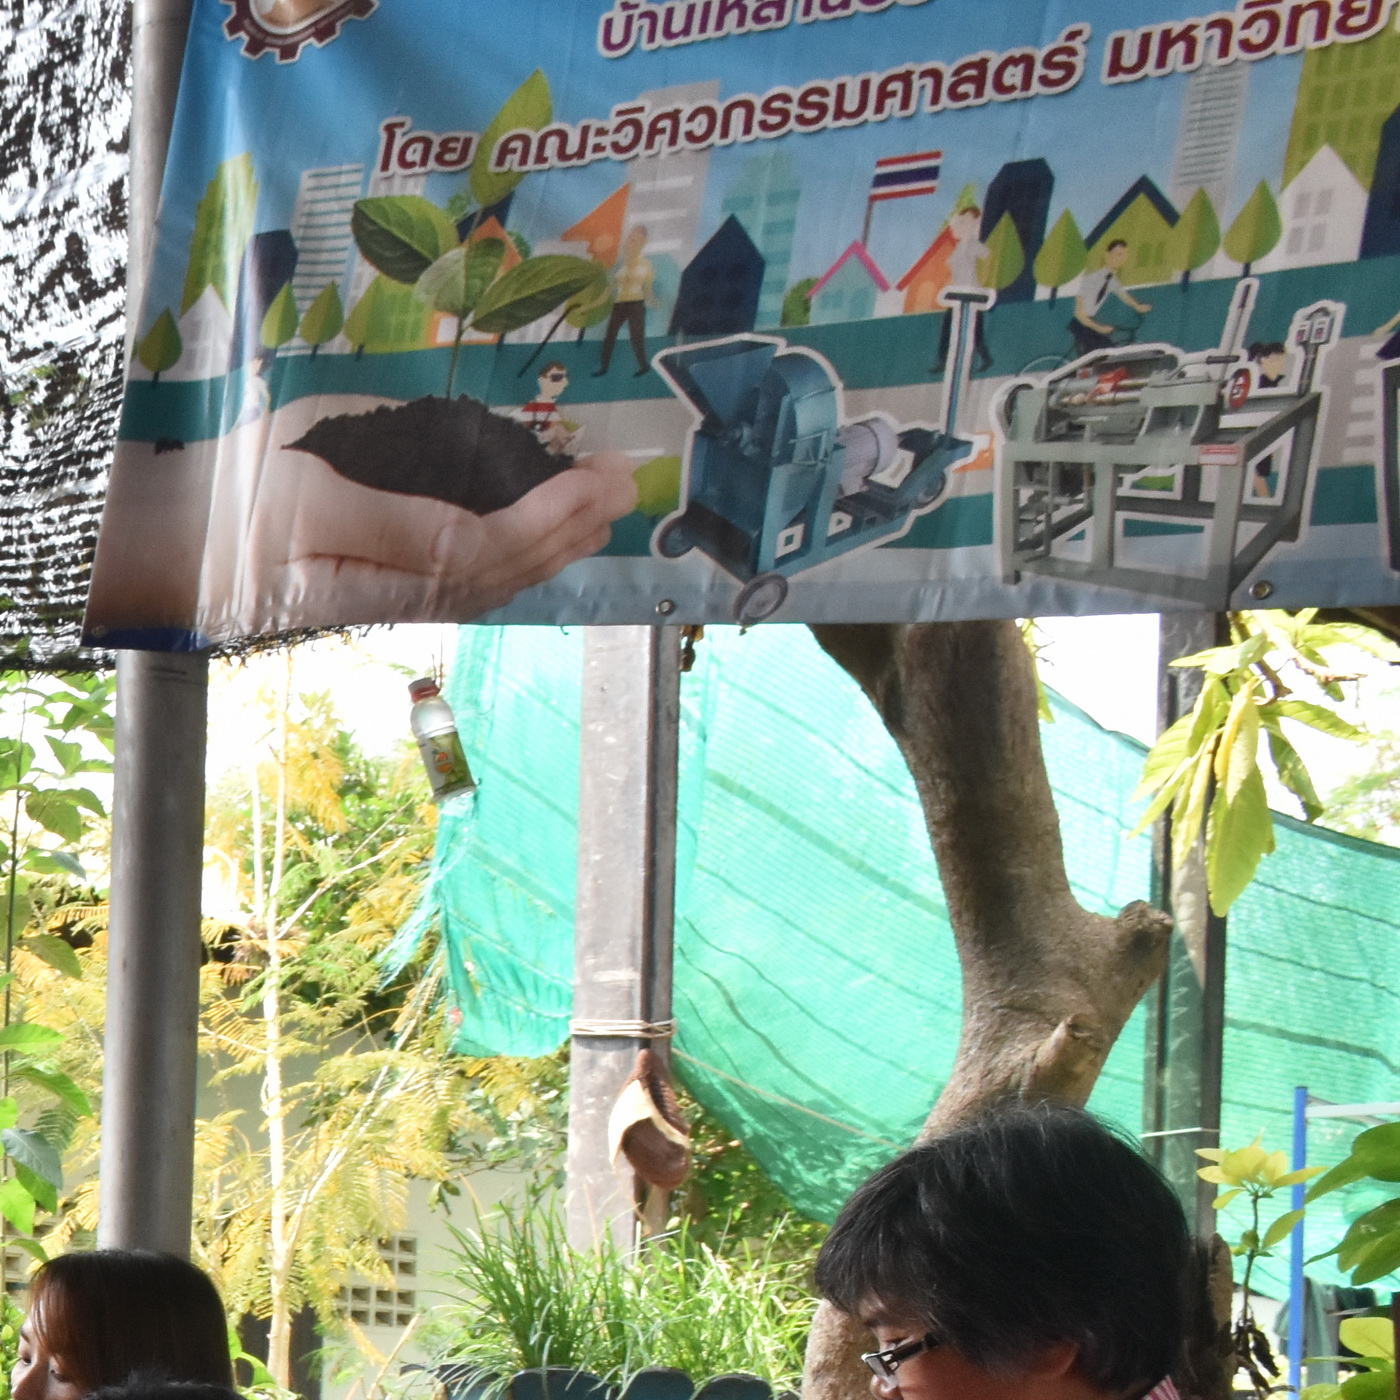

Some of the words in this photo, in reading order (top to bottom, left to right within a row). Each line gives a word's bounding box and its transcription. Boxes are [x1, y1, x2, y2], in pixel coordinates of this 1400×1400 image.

[380, 121, 473, 172] โดย
[495, 28, 1083, 168] คณะวิศวกรรมศาสตร์
